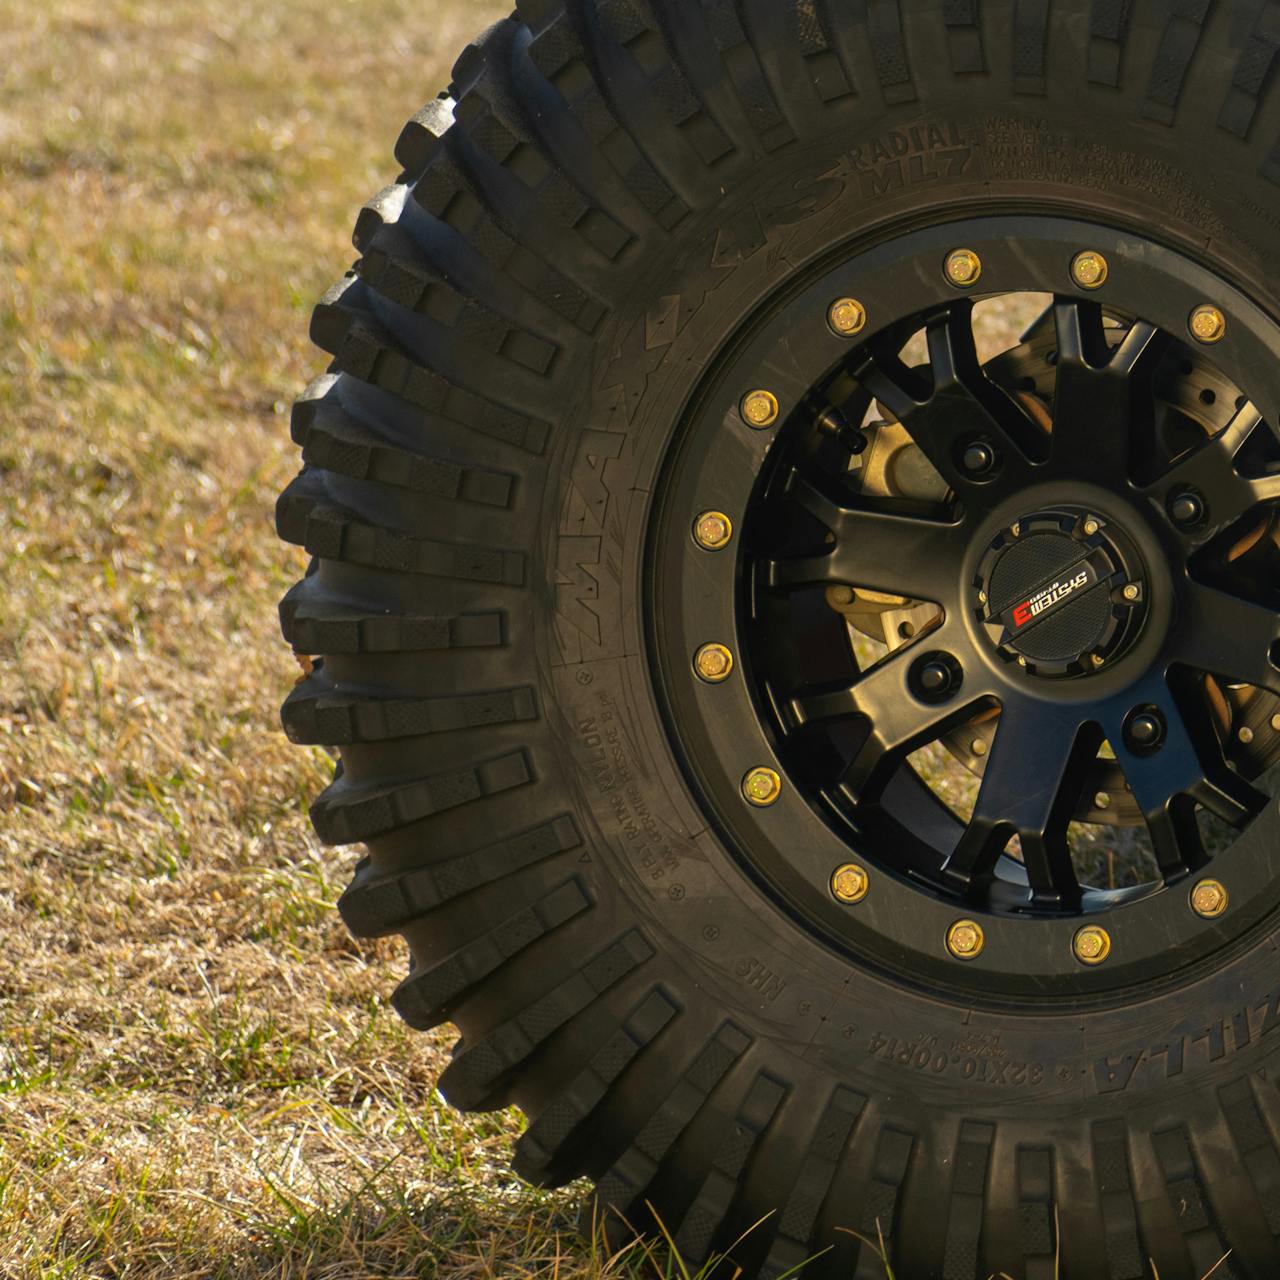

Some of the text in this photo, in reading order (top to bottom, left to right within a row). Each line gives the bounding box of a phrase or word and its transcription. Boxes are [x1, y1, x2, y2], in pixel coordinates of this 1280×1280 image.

[848, 120, 966, 169] RADIAL
[859, 147, 969, 199] ML7
[553, 158, 847, 646] MAXXIS
[574, 715, 621, 795] NYLON
[602, 725, 637, 786] PRESSURE
[605, 792, 643, 842] RATING
[632, 839, 660, 869] PLY
[735, 956, 788, 1003] NHS
[866, 1029, 1046, 1085] 32X10.00R14
